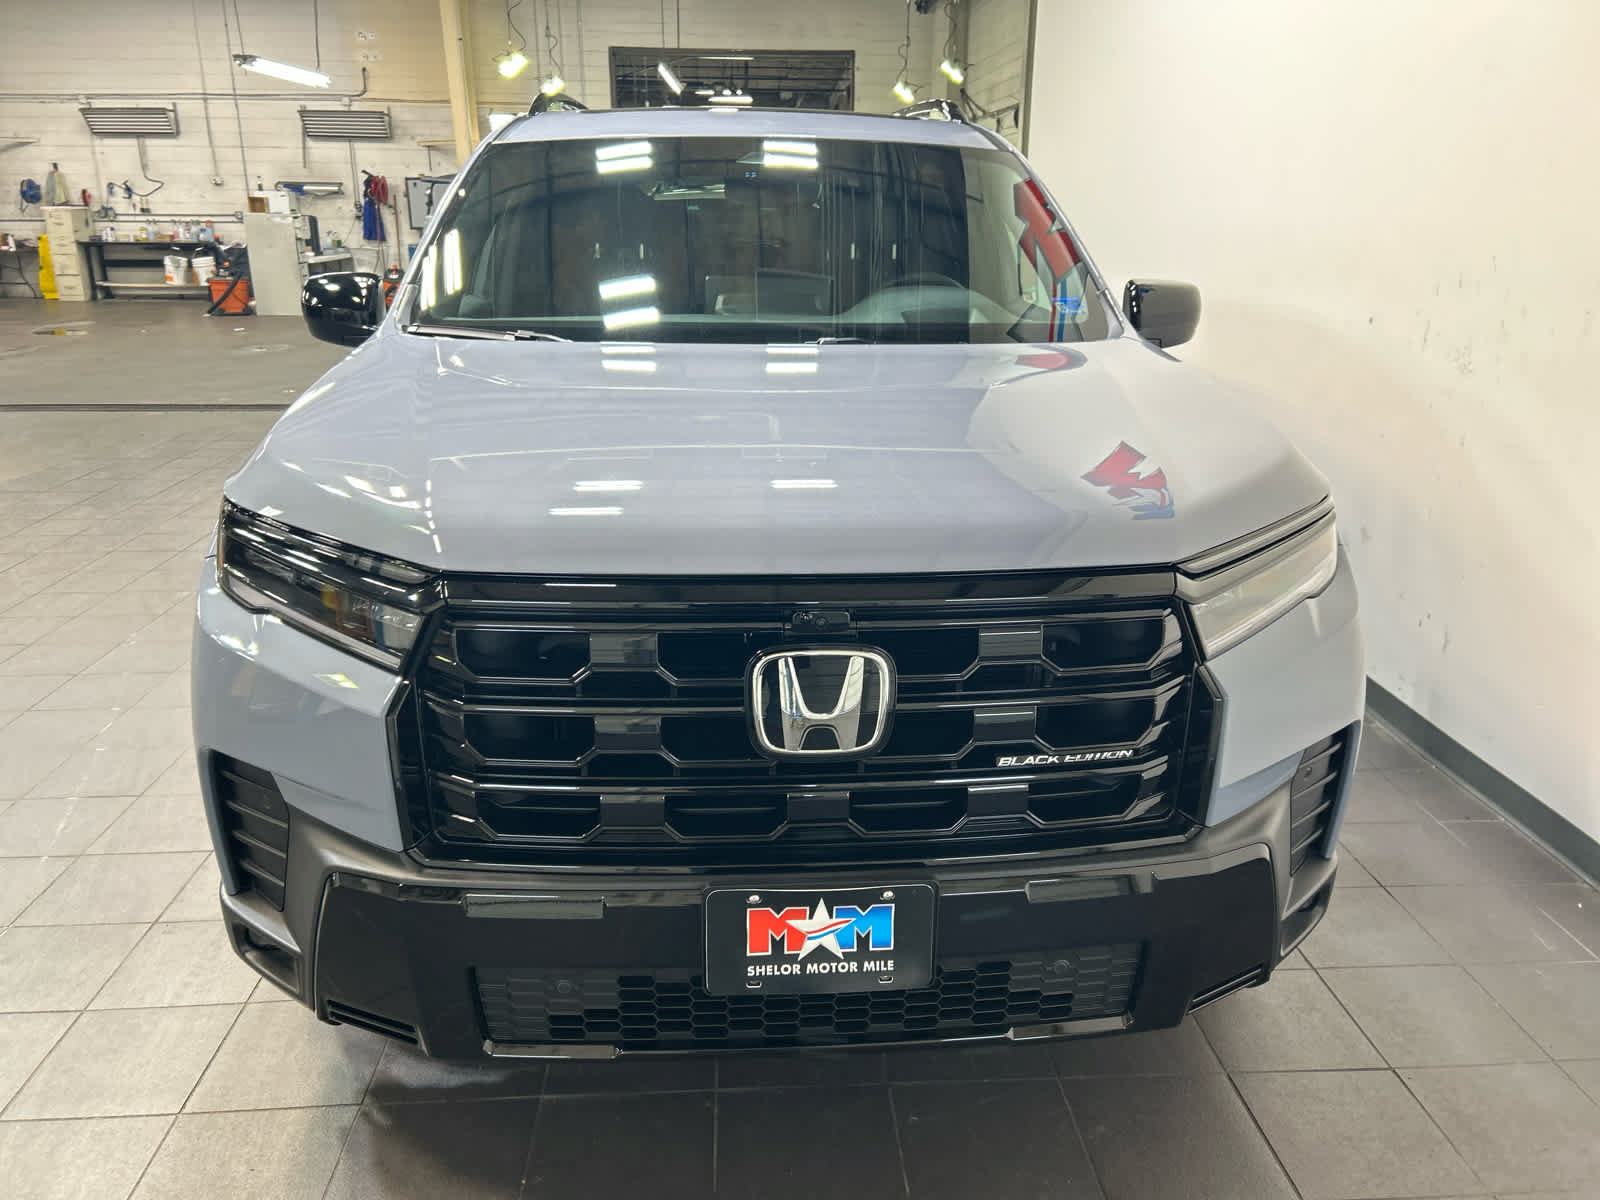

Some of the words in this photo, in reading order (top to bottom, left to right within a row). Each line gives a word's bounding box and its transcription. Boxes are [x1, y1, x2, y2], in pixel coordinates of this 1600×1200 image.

[997, 755, 1060, 767] BLACK
[1064, 749, 1134, 763] EDITION
[747, 963, 801, 977] SHELOR
[806, 961, 858, 975] MOTOR
[863, 960, 894, 973] MILE
